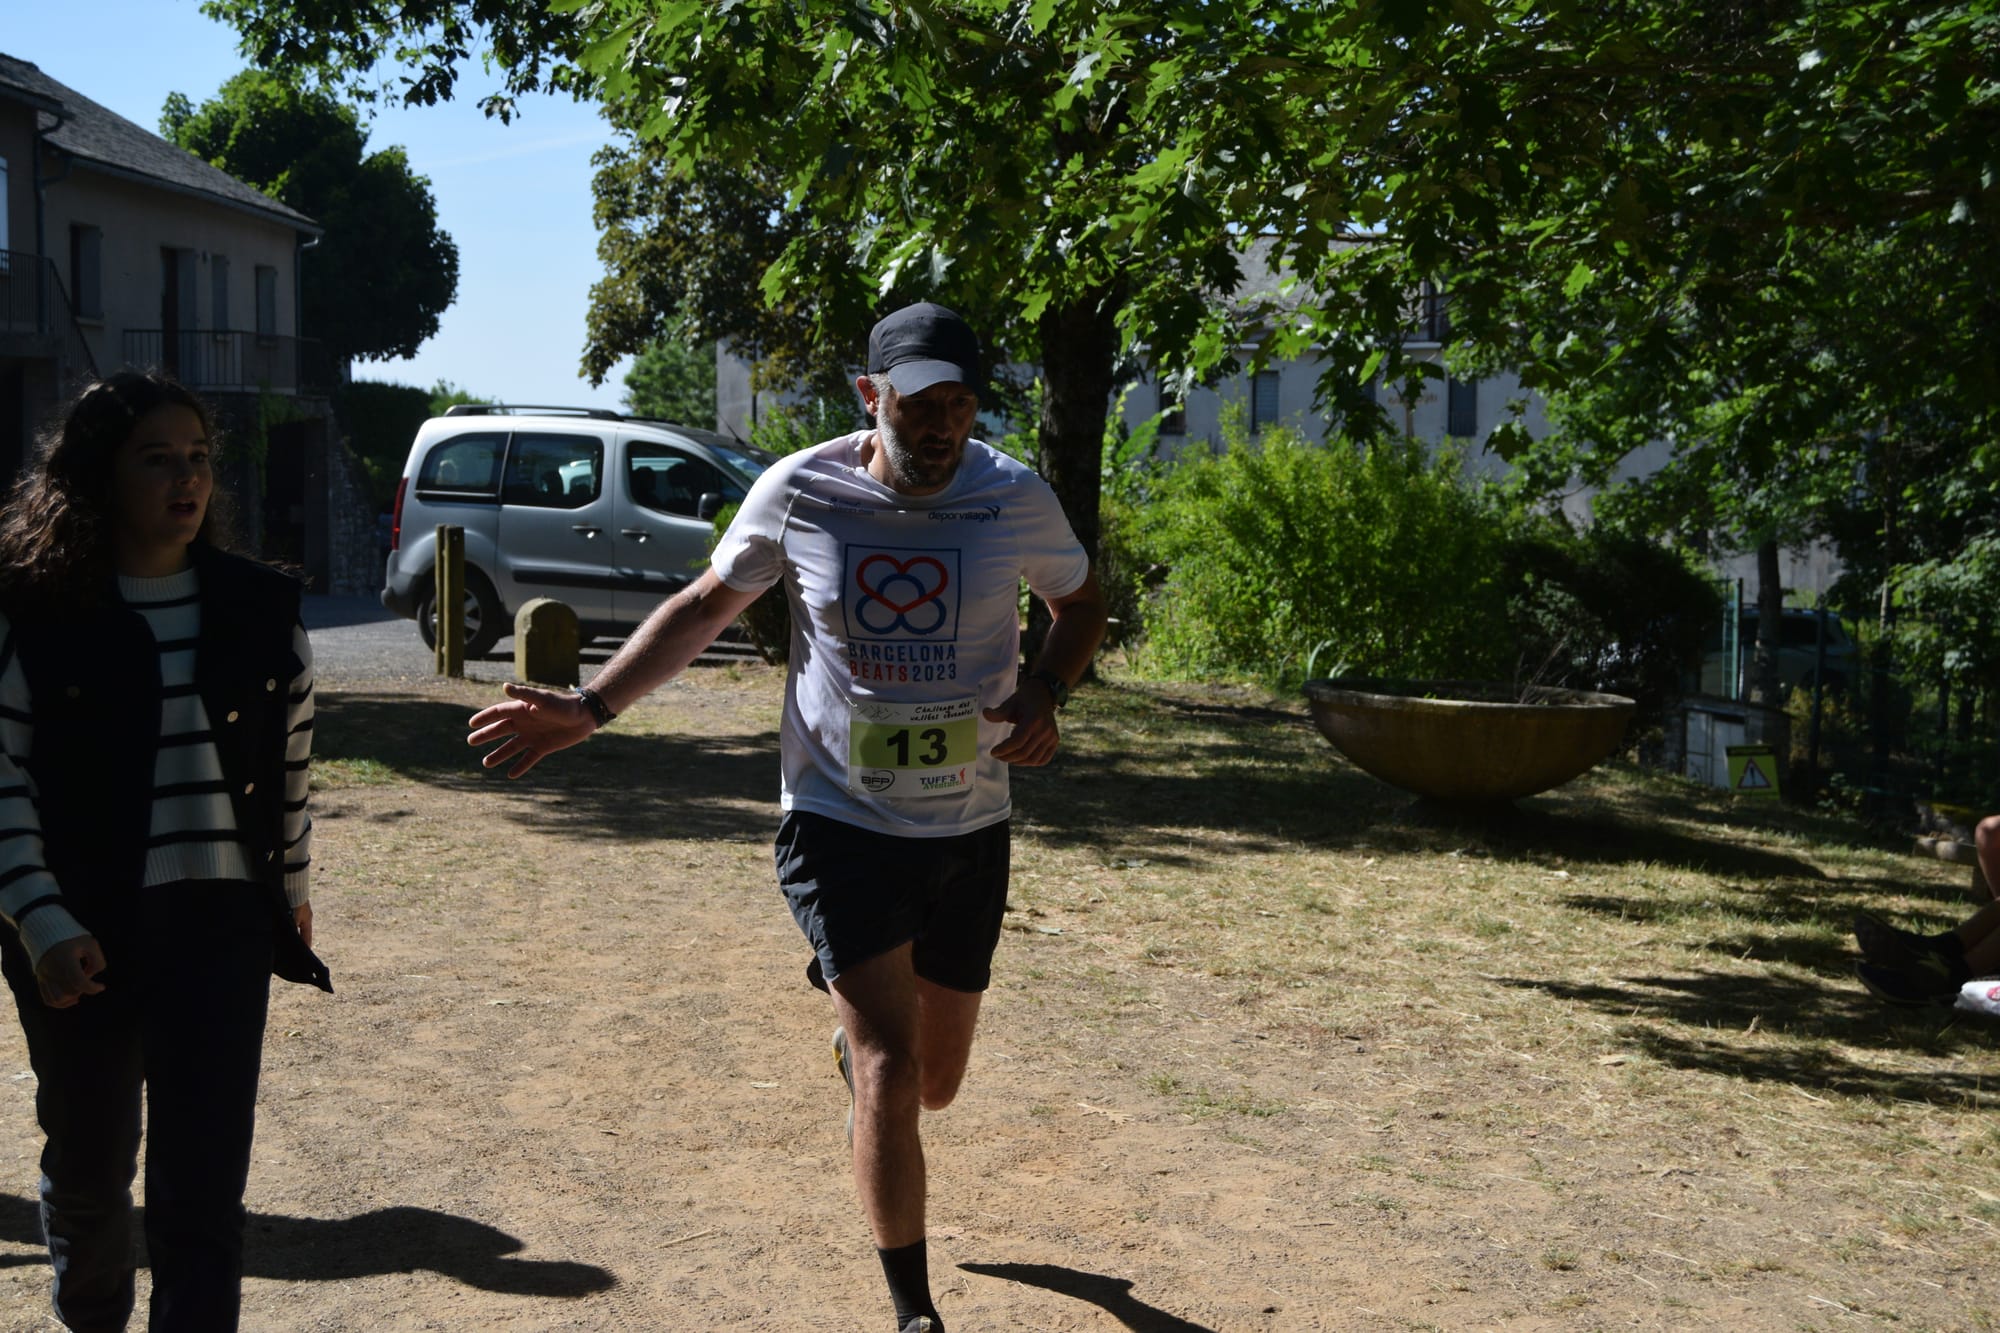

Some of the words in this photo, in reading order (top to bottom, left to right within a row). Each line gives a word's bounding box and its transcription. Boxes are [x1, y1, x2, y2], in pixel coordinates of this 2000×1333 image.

[928, 511, 991, 523] deporvillage
[848, 642, 956, 662] BARCELONA
[914, 705, 954, 714] Challenge
[887, 728, 948, 766] 13
[861, 776, 890, 785] BFP
[920, 773, 956, 785] TUFF'S
